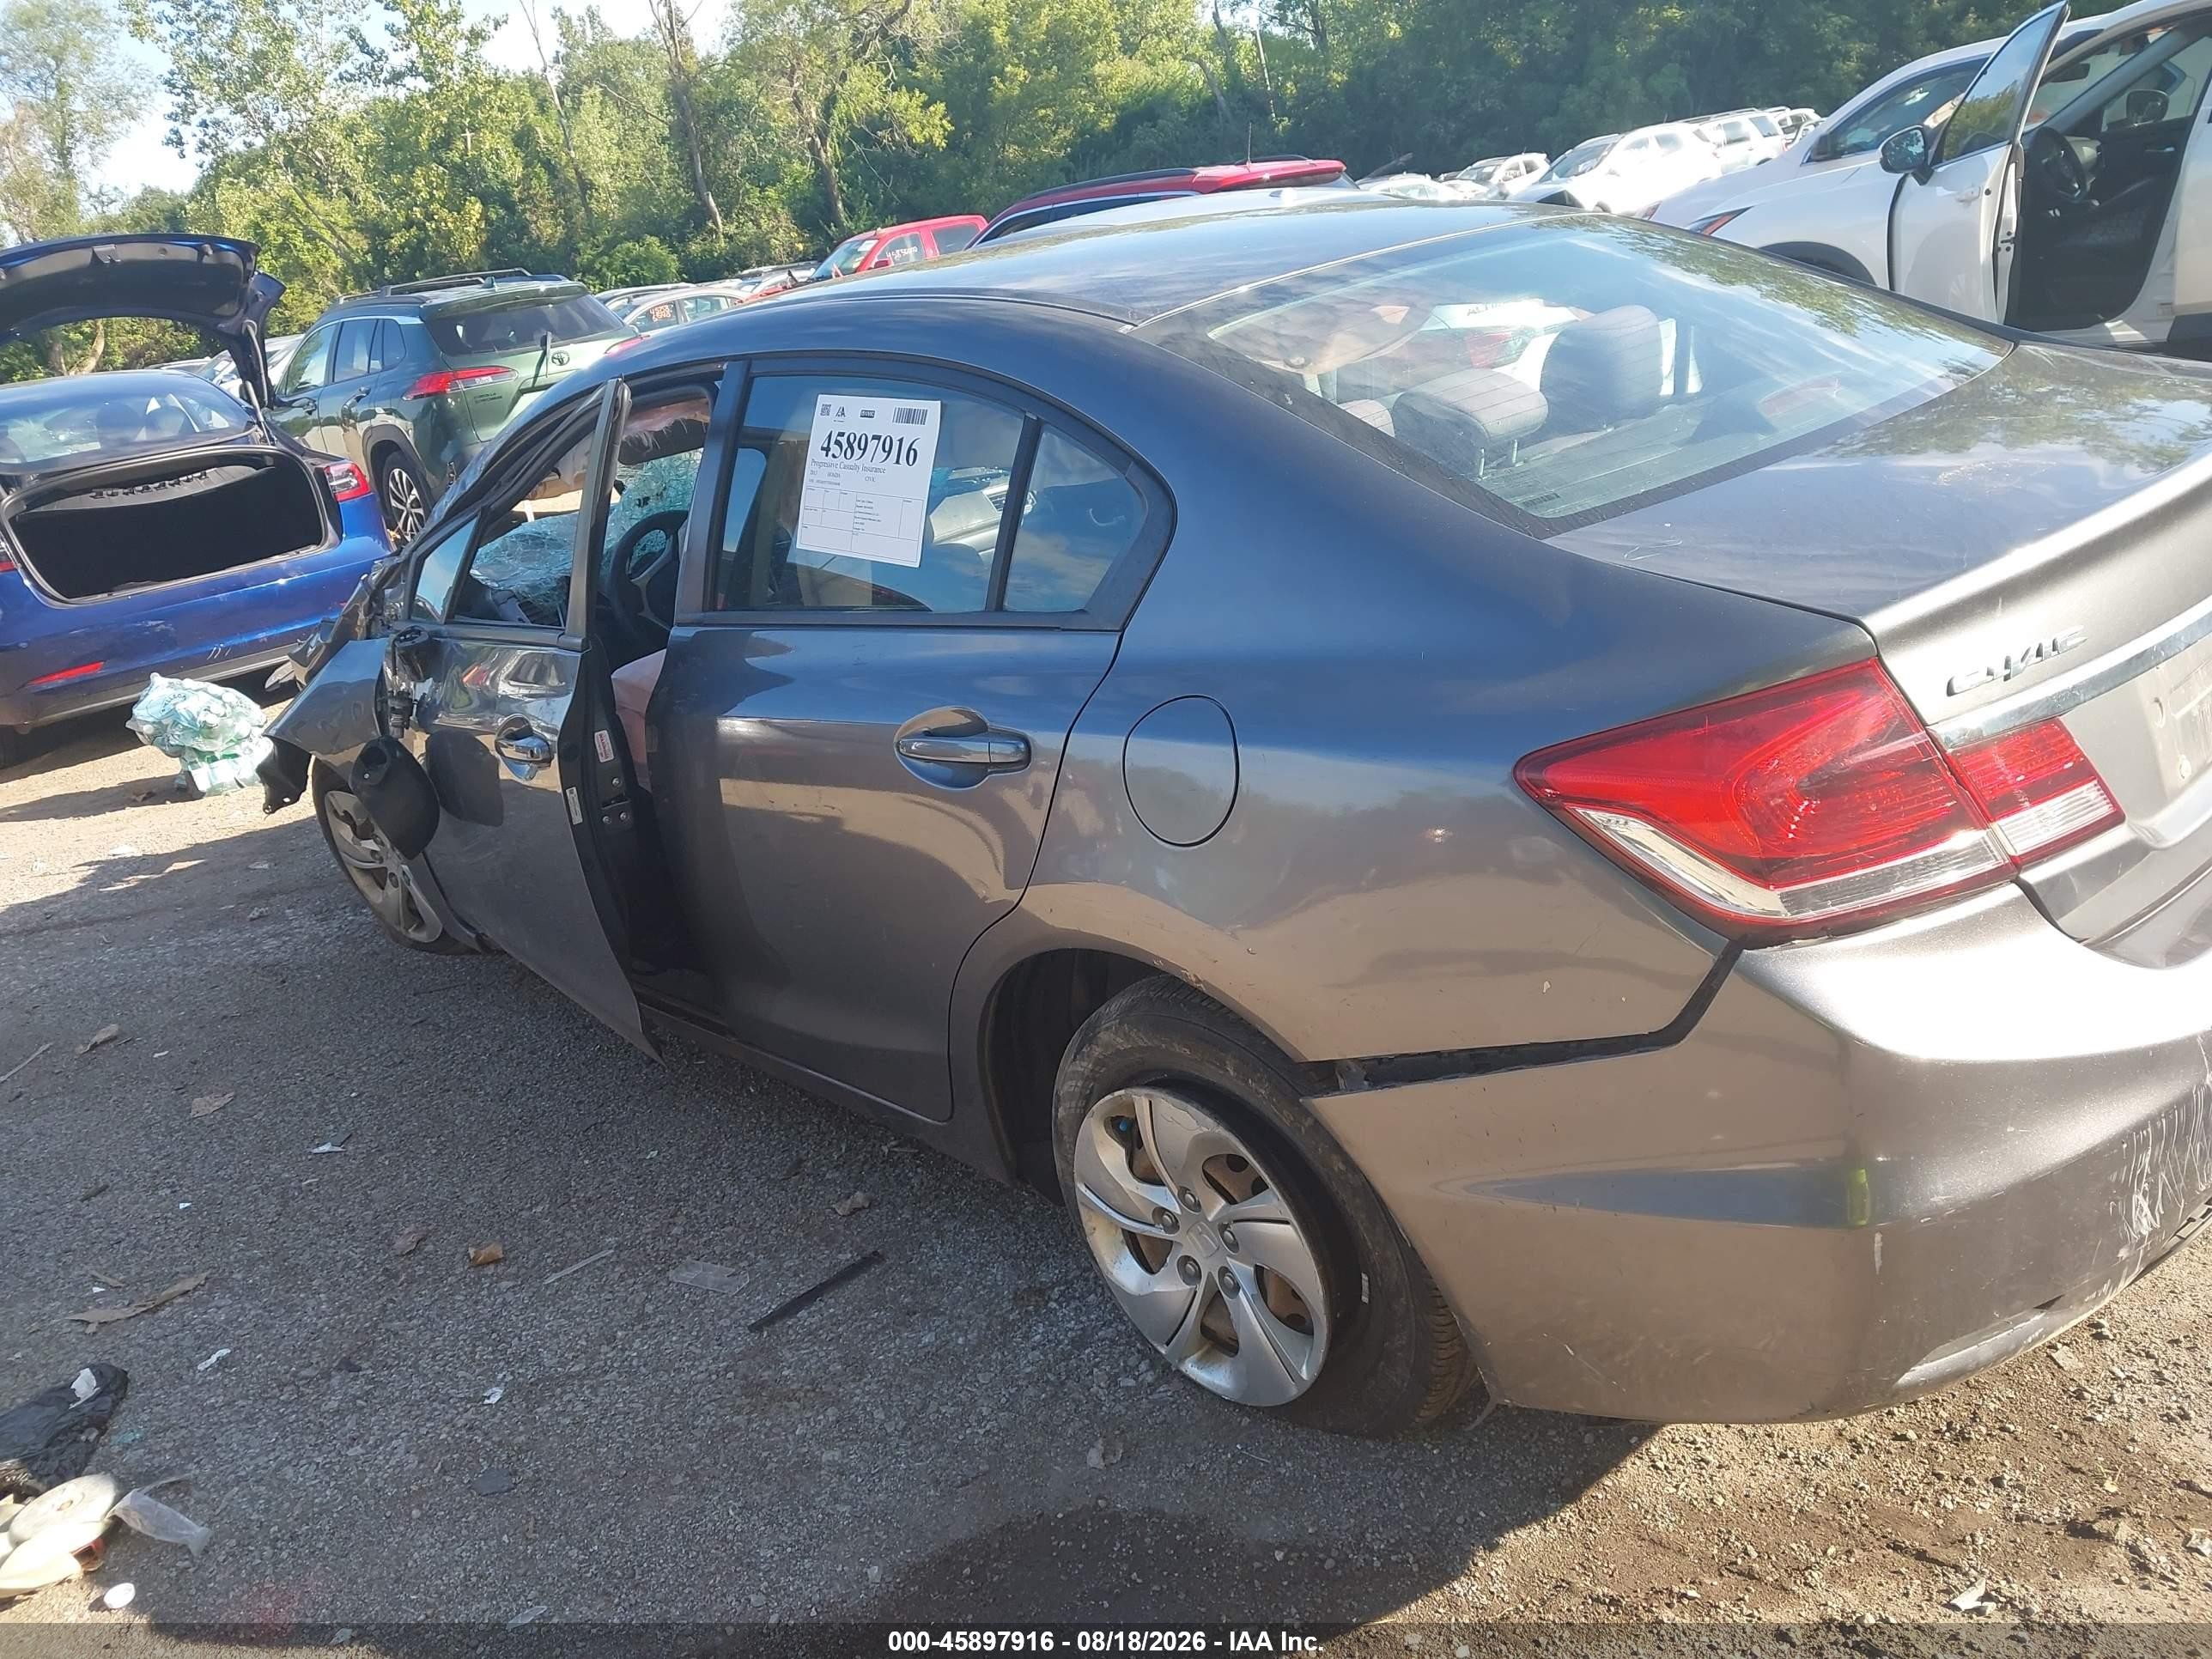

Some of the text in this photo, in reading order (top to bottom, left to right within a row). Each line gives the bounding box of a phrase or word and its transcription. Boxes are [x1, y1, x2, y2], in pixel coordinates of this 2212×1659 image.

[811, 459, 886, 474] Progressive Casualty Insurance
[820, 429, 921, 467] 45897916
[1946, 624, 2088, 697] CIVIC
